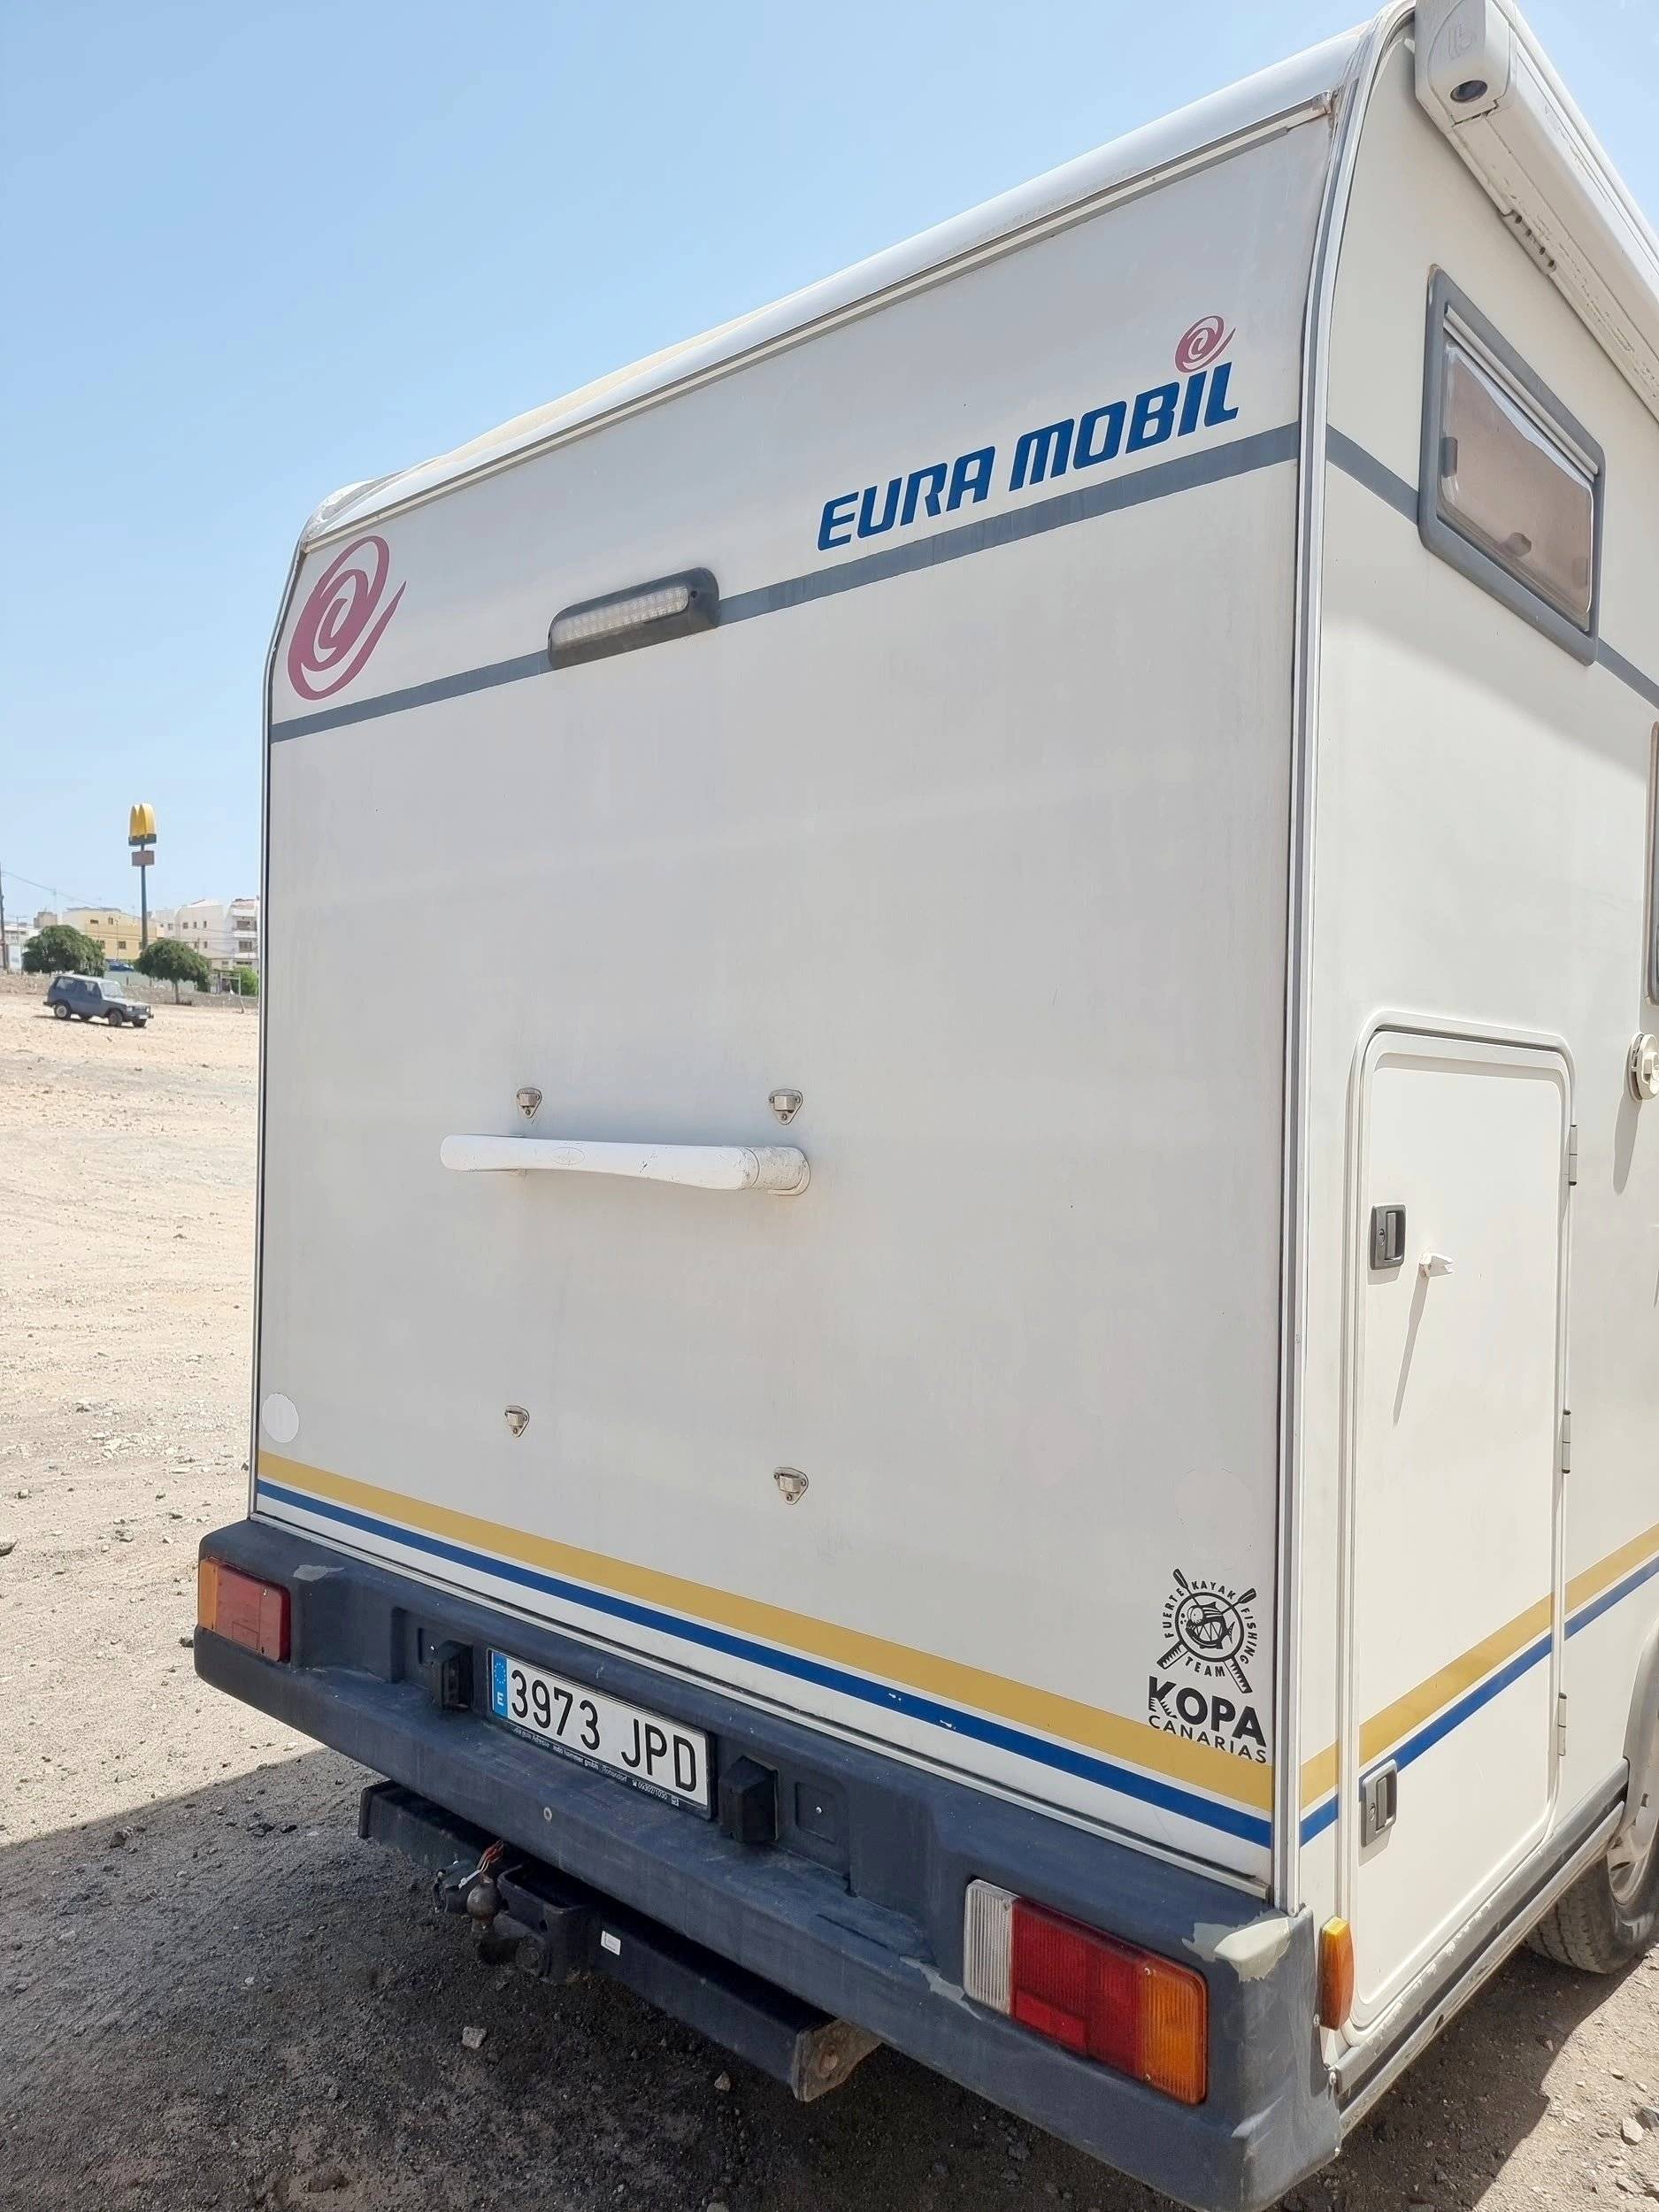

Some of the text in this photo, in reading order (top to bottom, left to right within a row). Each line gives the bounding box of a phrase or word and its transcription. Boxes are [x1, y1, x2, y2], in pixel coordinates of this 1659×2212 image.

[818, 360, 1240, 552] EURA MOBIL
[1162, 1580, 1257, 1665] FUERTE KAYAK FISHING
[496, 1691, 504, 1707] E
[1185, 1655, 1226, 1678] TEAM
[511, 1669, 697, 1793] 3973 JPD
[1148, 1675, 1267, 1748] KOPA
[1148, 1715, 1267, 1764] CANARIAS
